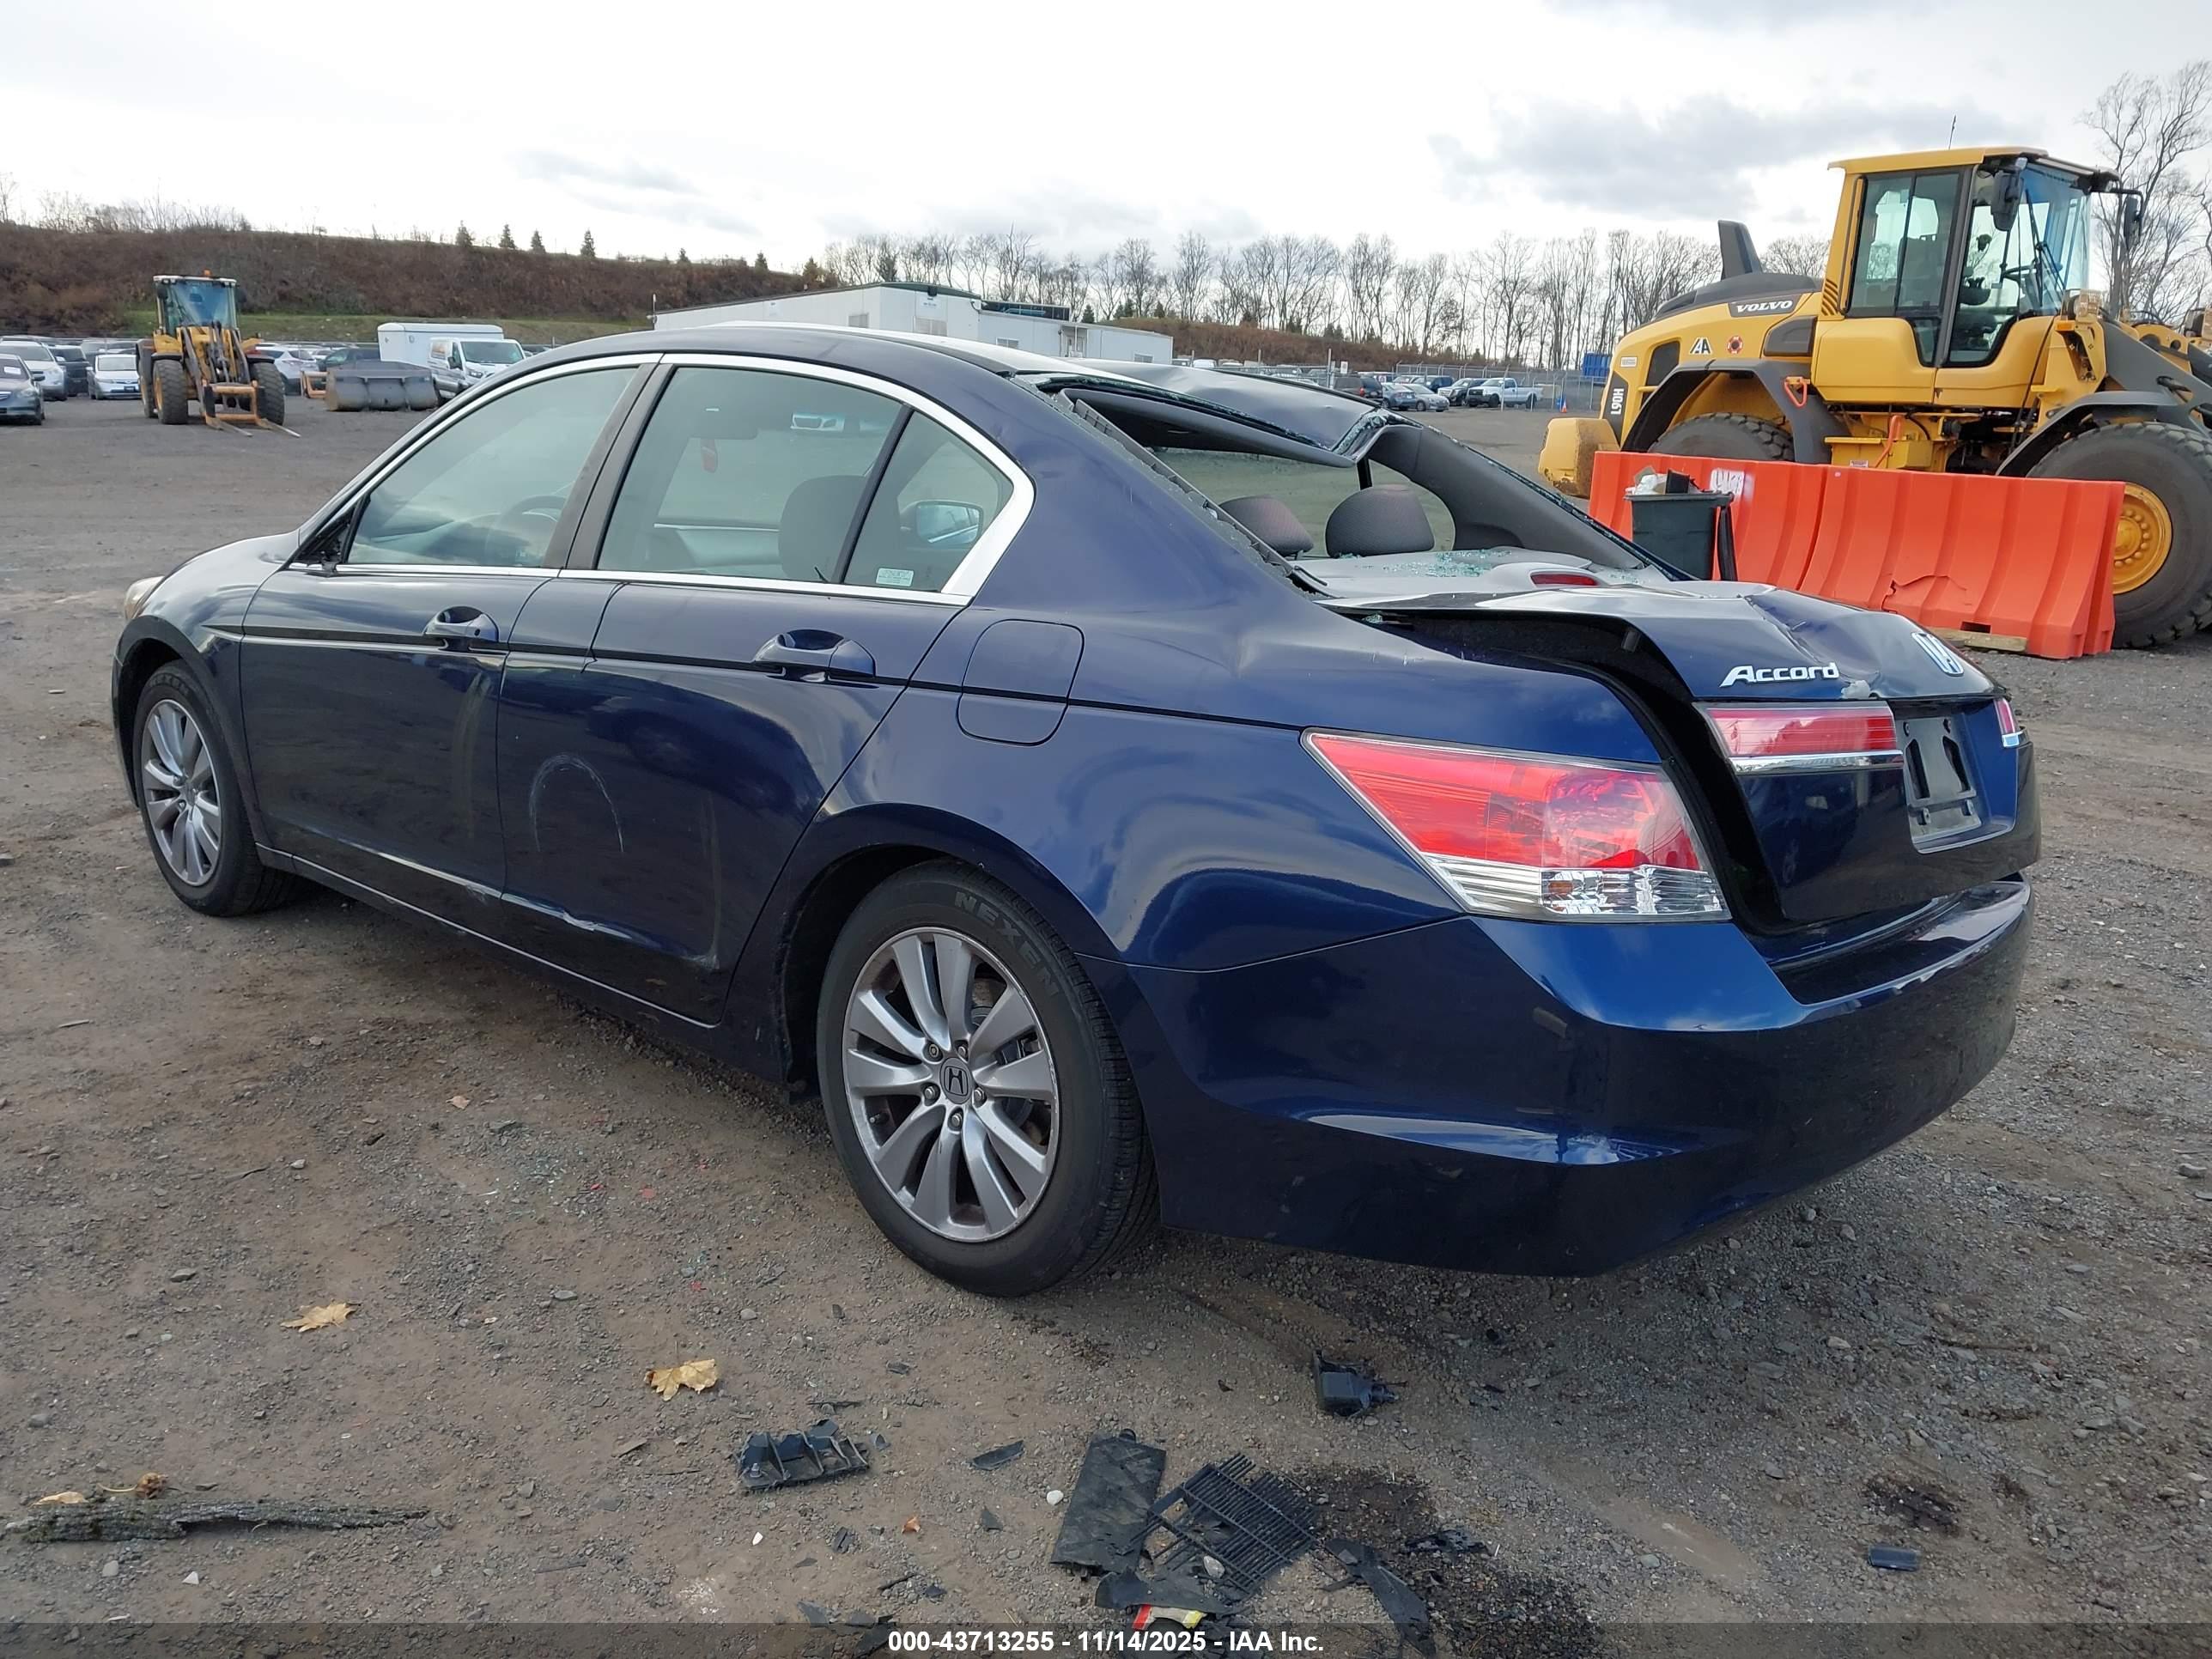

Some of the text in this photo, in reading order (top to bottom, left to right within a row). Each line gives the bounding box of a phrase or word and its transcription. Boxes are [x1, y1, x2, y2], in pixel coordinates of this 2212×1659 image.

[1736, 300, 1793, 313] VOLVO
[1610, 387, 1625, 415] L90H
[1719, 662, 1839, 688] Accord
[954, 890, 1060, 998] NEXEN
